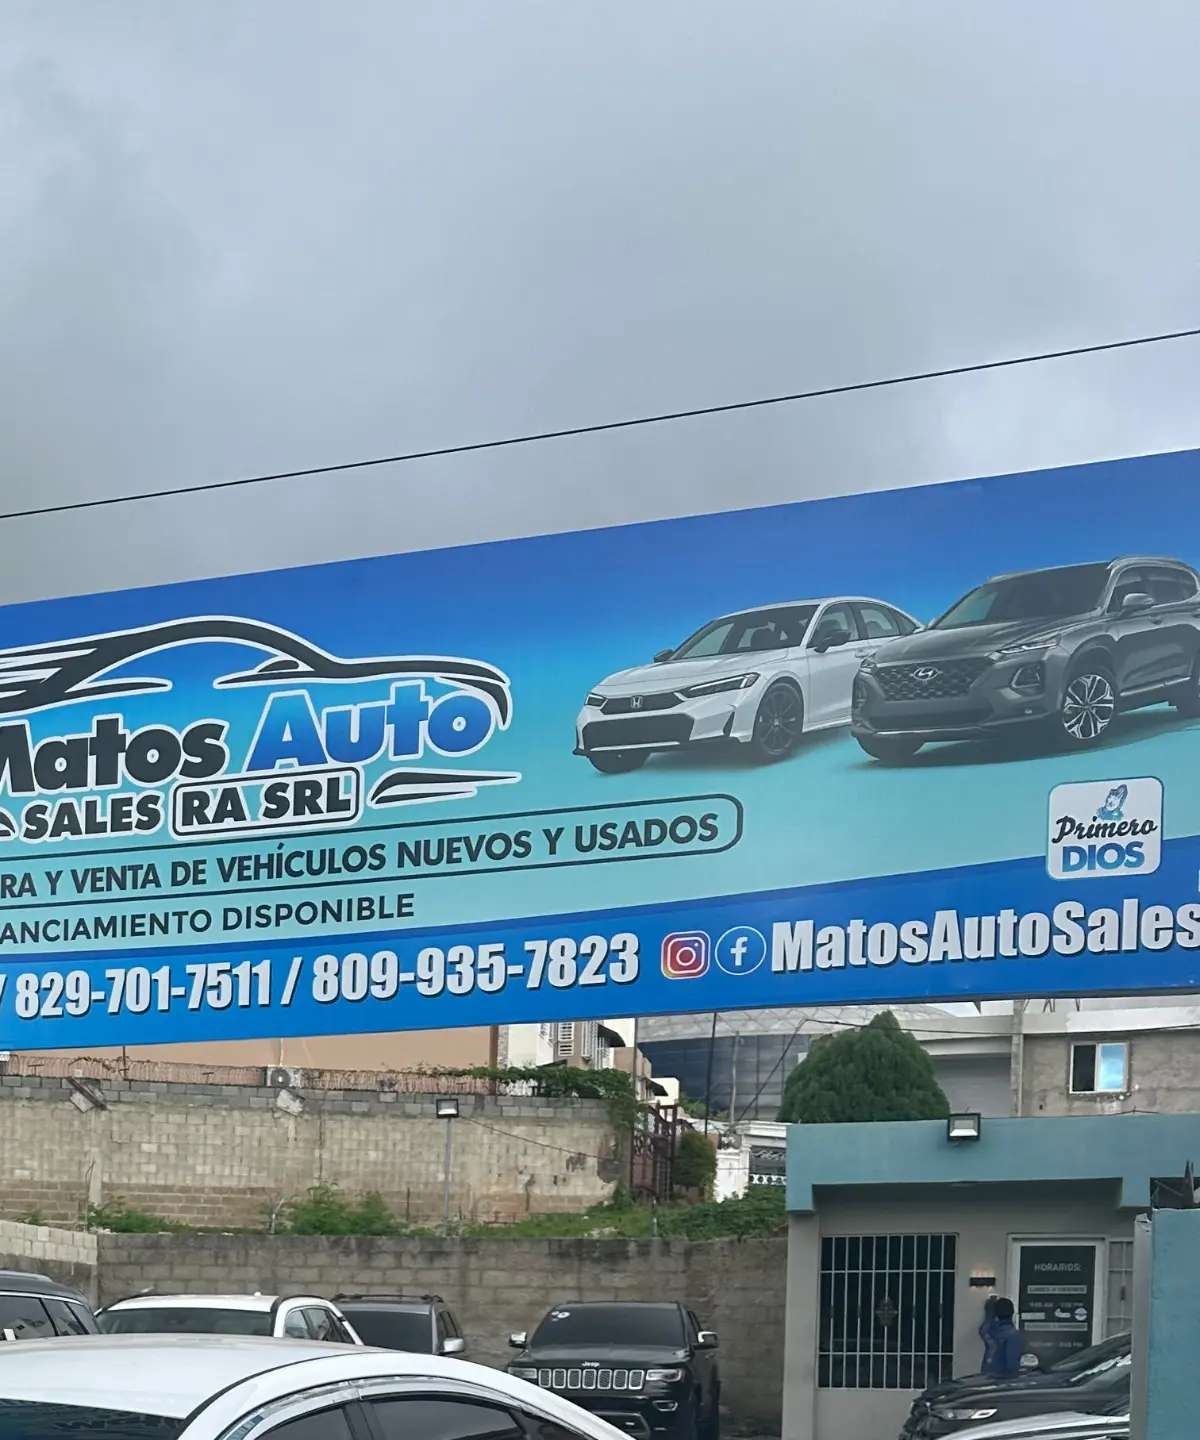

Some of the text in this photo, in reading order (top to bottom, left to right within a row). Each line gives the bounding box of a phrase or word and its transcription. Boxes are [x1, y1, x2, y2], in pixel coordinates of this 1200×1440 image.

[243, 680, 494, 772] Auto
[23, 775, 351, 839] SALES RA SRL
[1051, 815, 1158, 844] Primero
[45, 869, 64, 897] Y
[71, 864, 160, 895] VENTA
[171, 859, 207, 886] DE
[216, 843, 387, 882] VEHÍCULOS
[396, 828, 532, 870] NUEVOS
[542, 827, 565, 855] Y
[574, 812, 719, 853] USADOS
[1062, 840, 1145, 873] DIOS
[222, 892, 415, 931] DISPONIBLE
[771, 898, 1200, 974] MatosAutoSales
[14, 958, 272, 1020] 829-701-7511
[312, 932, 640, 1005] 809-935-7823
